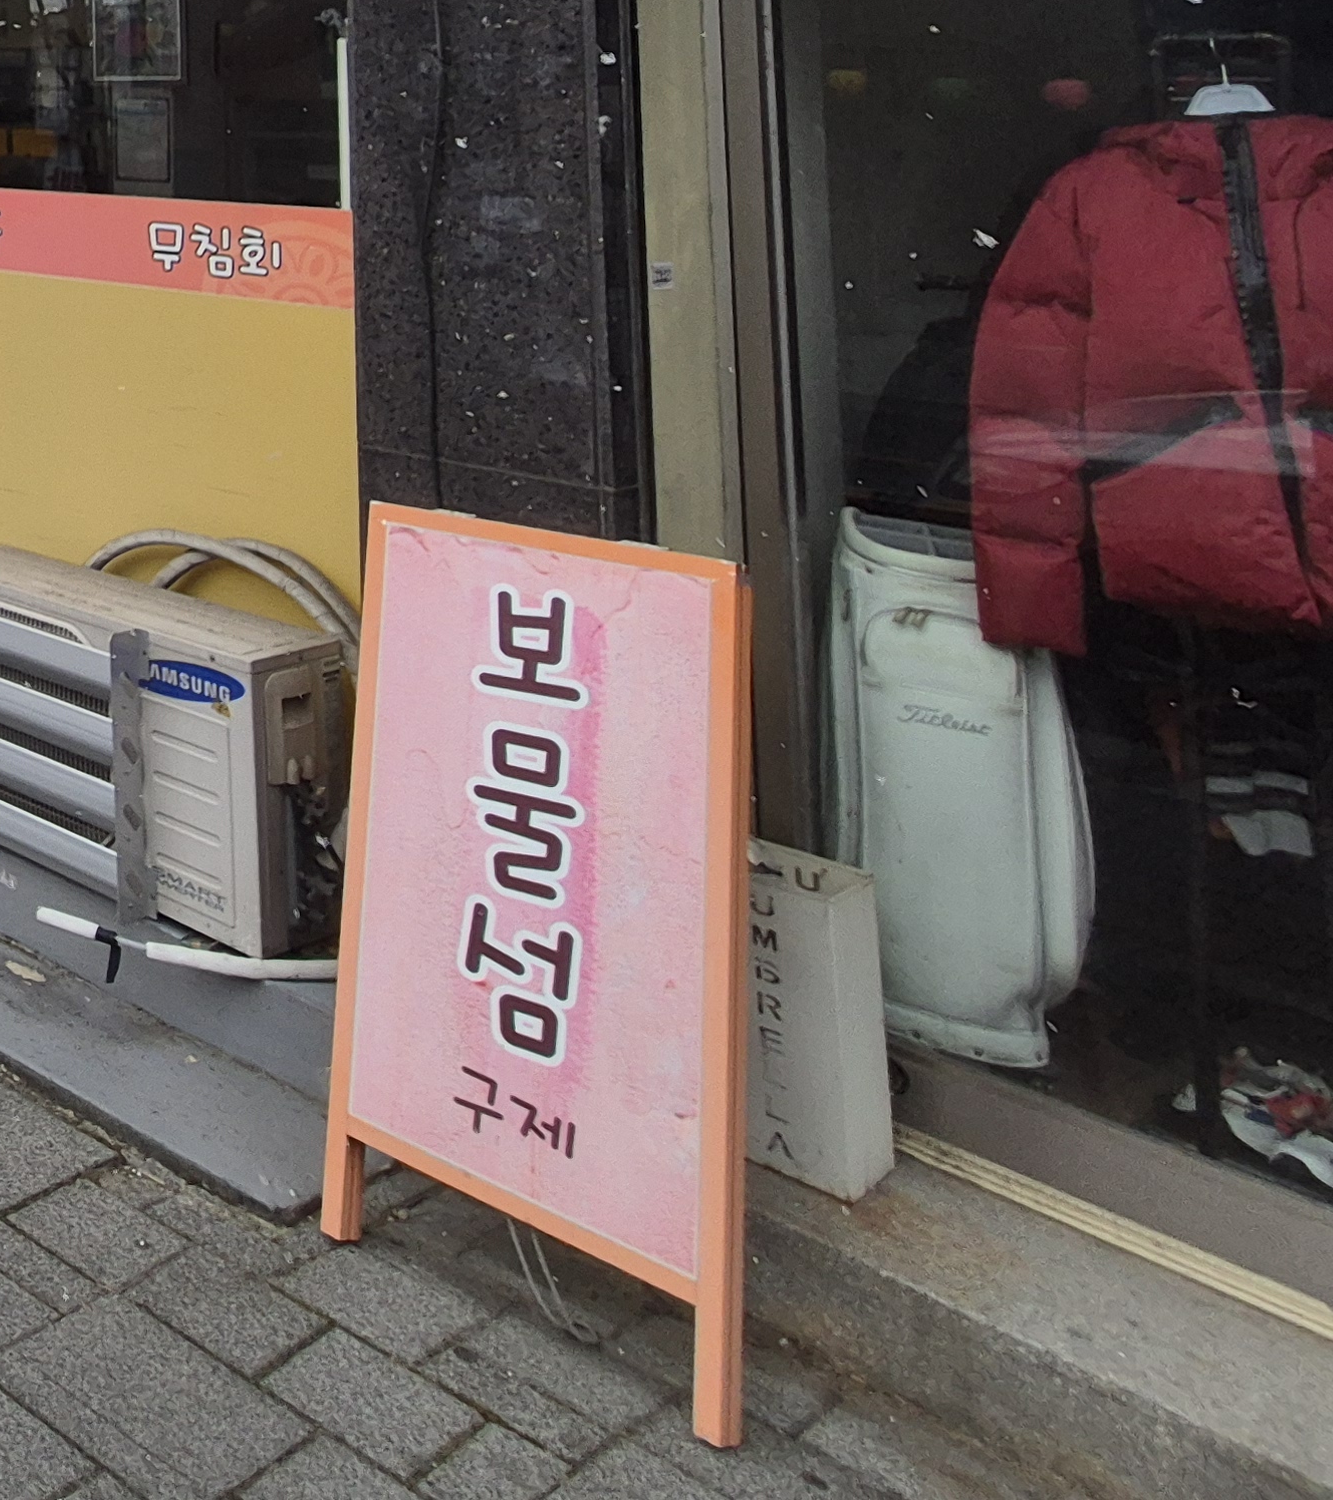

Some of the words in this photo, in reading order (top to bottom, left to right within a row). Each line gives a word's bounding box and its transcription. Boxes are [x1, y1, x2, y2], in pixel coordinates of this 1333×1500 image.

[148, 221, 282, 279] 무침회
[149, 662, 232, 702] AMSUNG
[461, 585, 586, 1063] 보물섬
[453, 1065, 576, 1160] 구제
